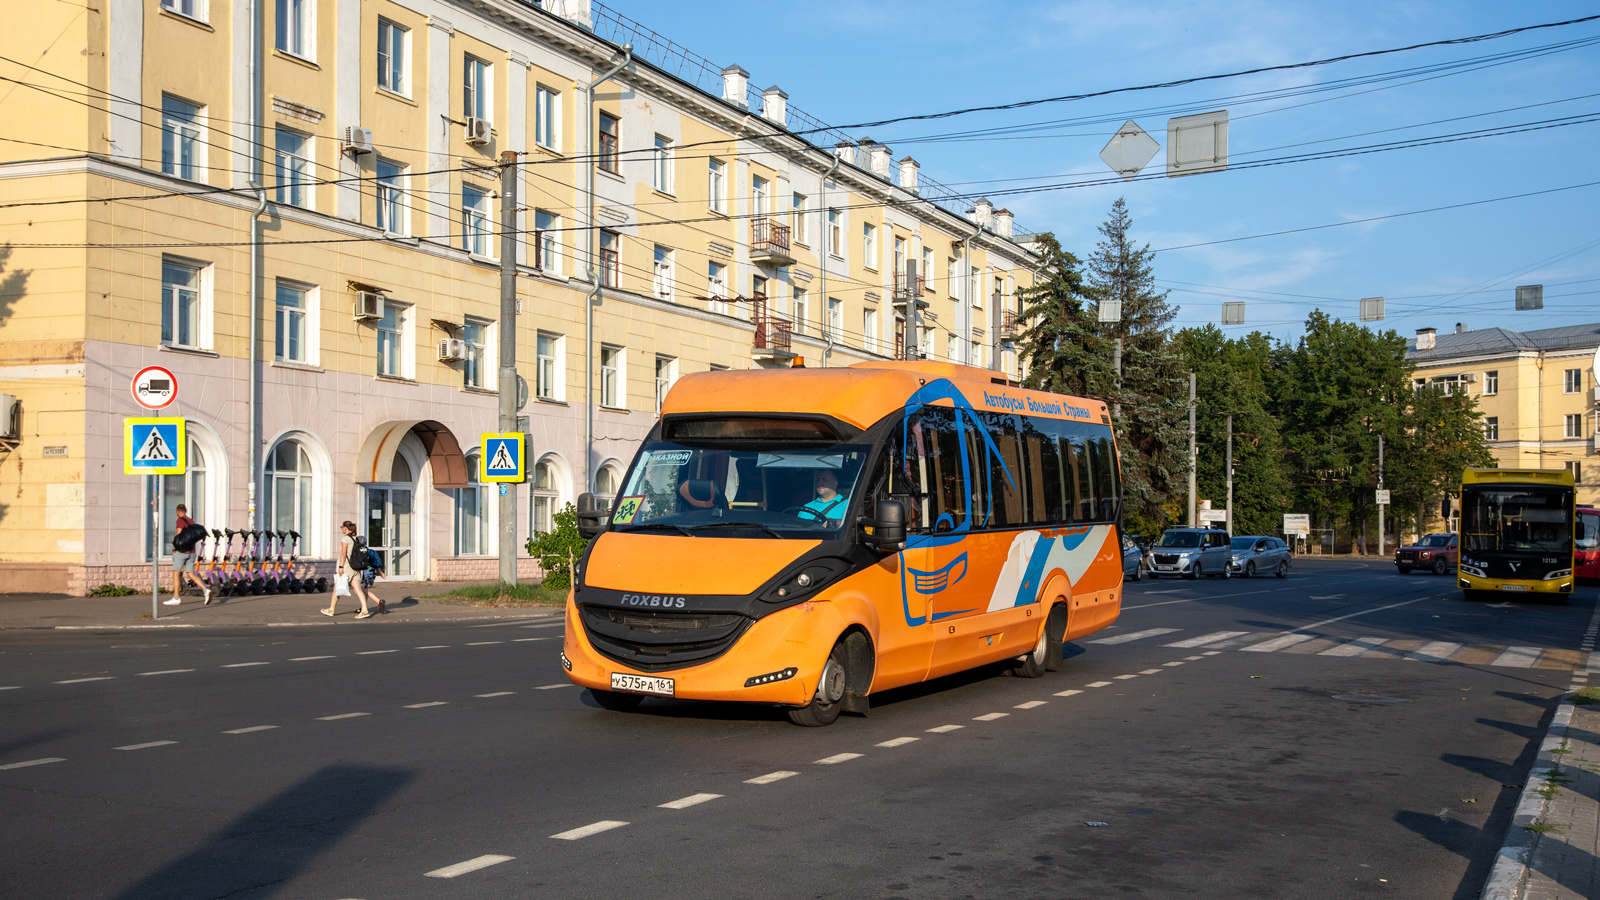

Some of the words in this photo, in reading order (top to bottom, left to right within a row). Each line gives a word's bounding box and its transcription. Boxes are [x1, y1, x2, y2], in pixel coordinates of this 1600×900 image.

[984, 391, 1025, 412] Автобусы
[1026, 397, 1062, 415] Большой
[1063, 402, 1091, 420] Страны
[620, 593, 686, 608] FOXBUS
[615, 676, 653, 690] У575РА
[655, 679, 671, 689] 161
